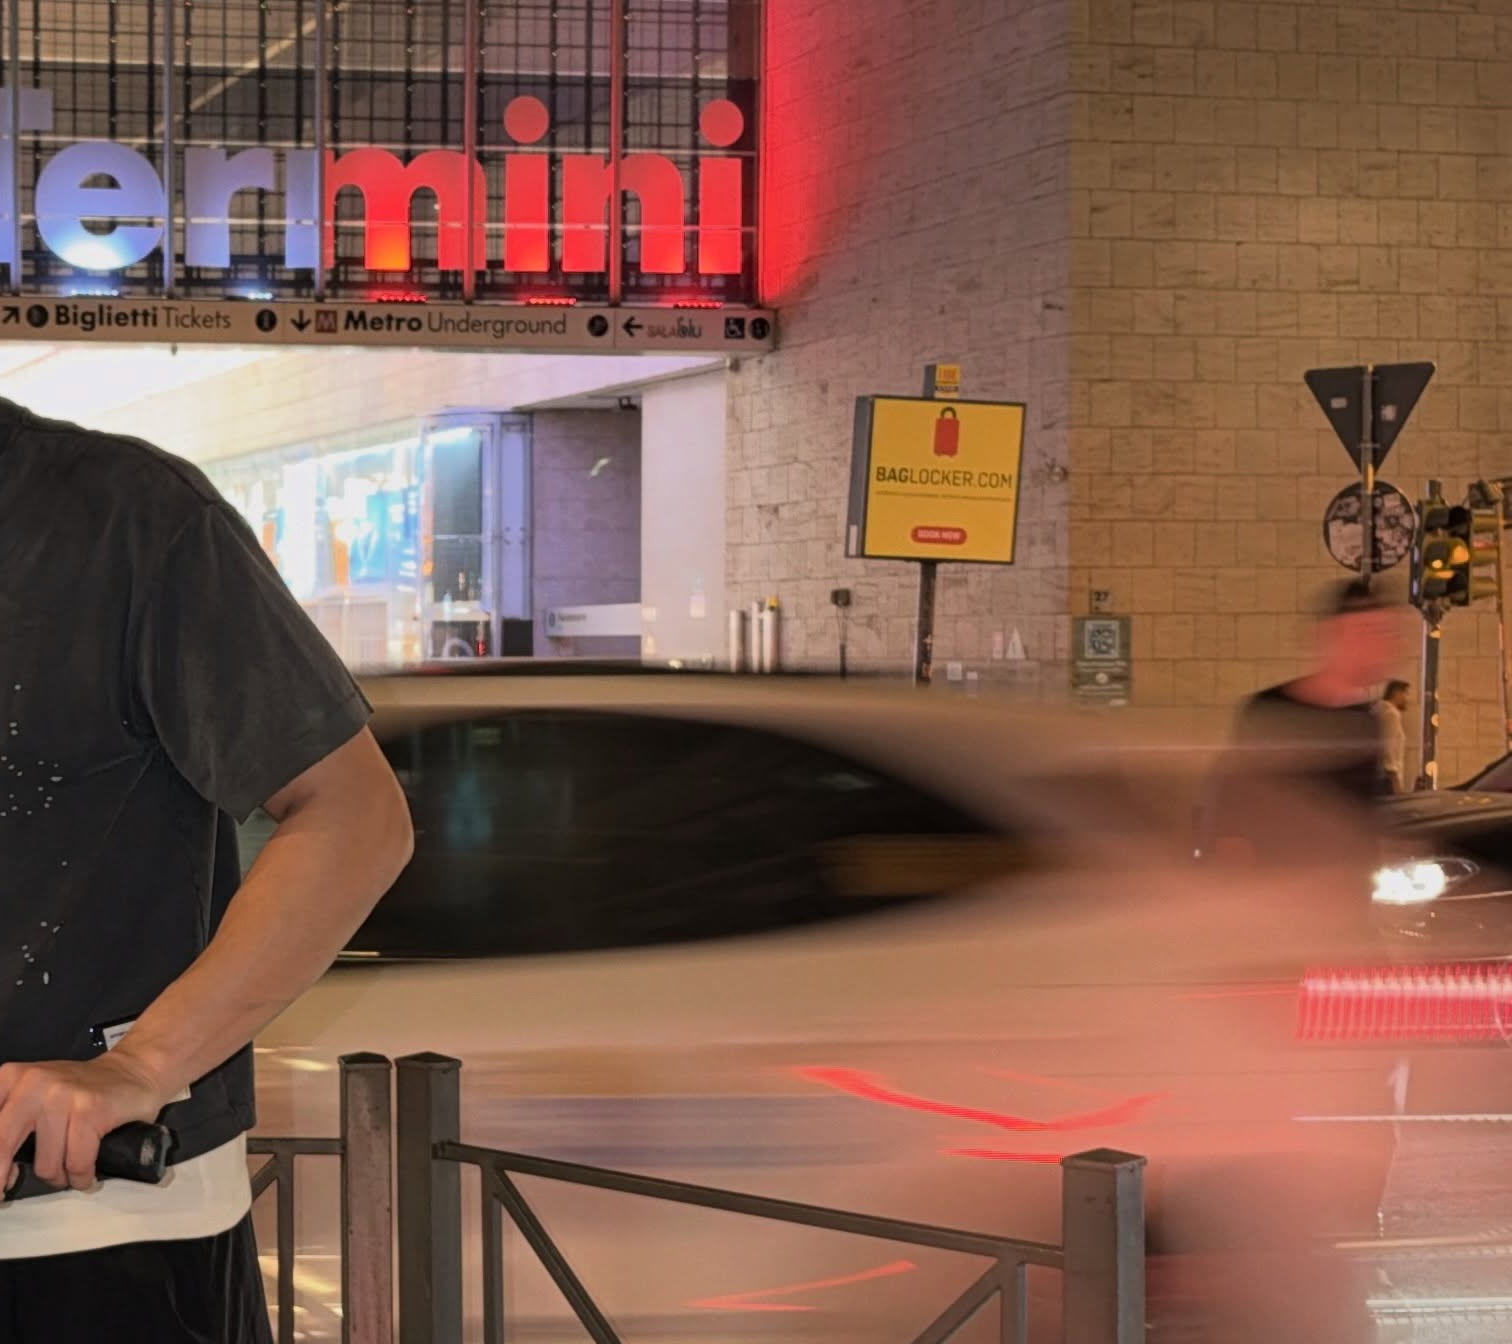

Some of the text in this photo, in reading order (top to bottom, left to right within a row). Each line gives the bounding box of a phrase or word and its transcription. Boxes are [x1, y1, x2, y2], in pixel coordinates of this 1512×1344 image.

[55, 304, 231, 331] Biglietti Tickets
[344, 311, 422, 332] Metro
[427, 312, 567, 338] Underground
[875, 466, 1013, 489] BAGLOCKER.COM
